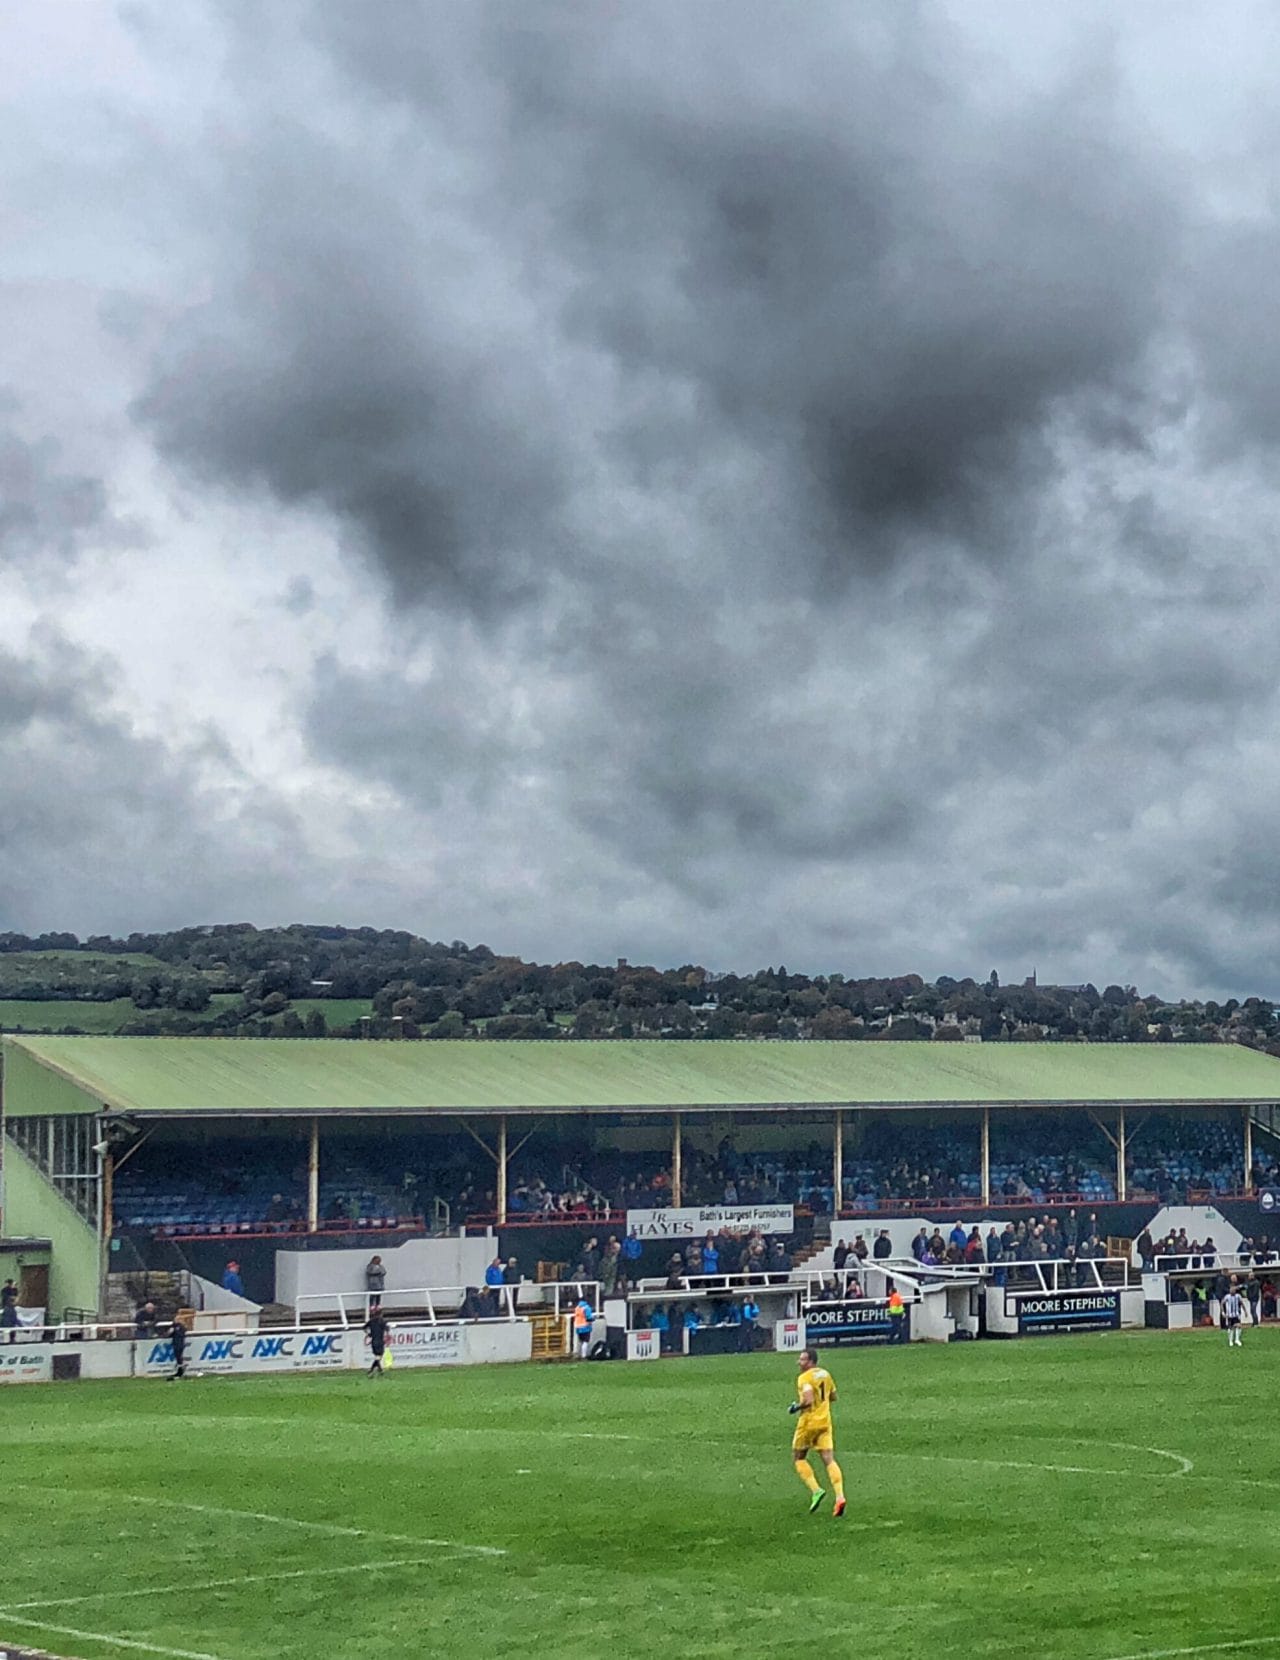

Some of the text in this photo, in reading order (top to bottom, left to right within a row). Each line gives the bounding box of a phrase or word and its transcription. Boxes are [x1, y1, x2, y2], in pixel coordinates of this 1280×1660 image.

[700, 1207, 791, 1222] Bath's Largest Furnishers
[631, 1222, 693, 1236] HAYES
[1021, 1297, 1116, 1313] MOORE STEPHENS
[819, 1381, 825, 1401] 1
